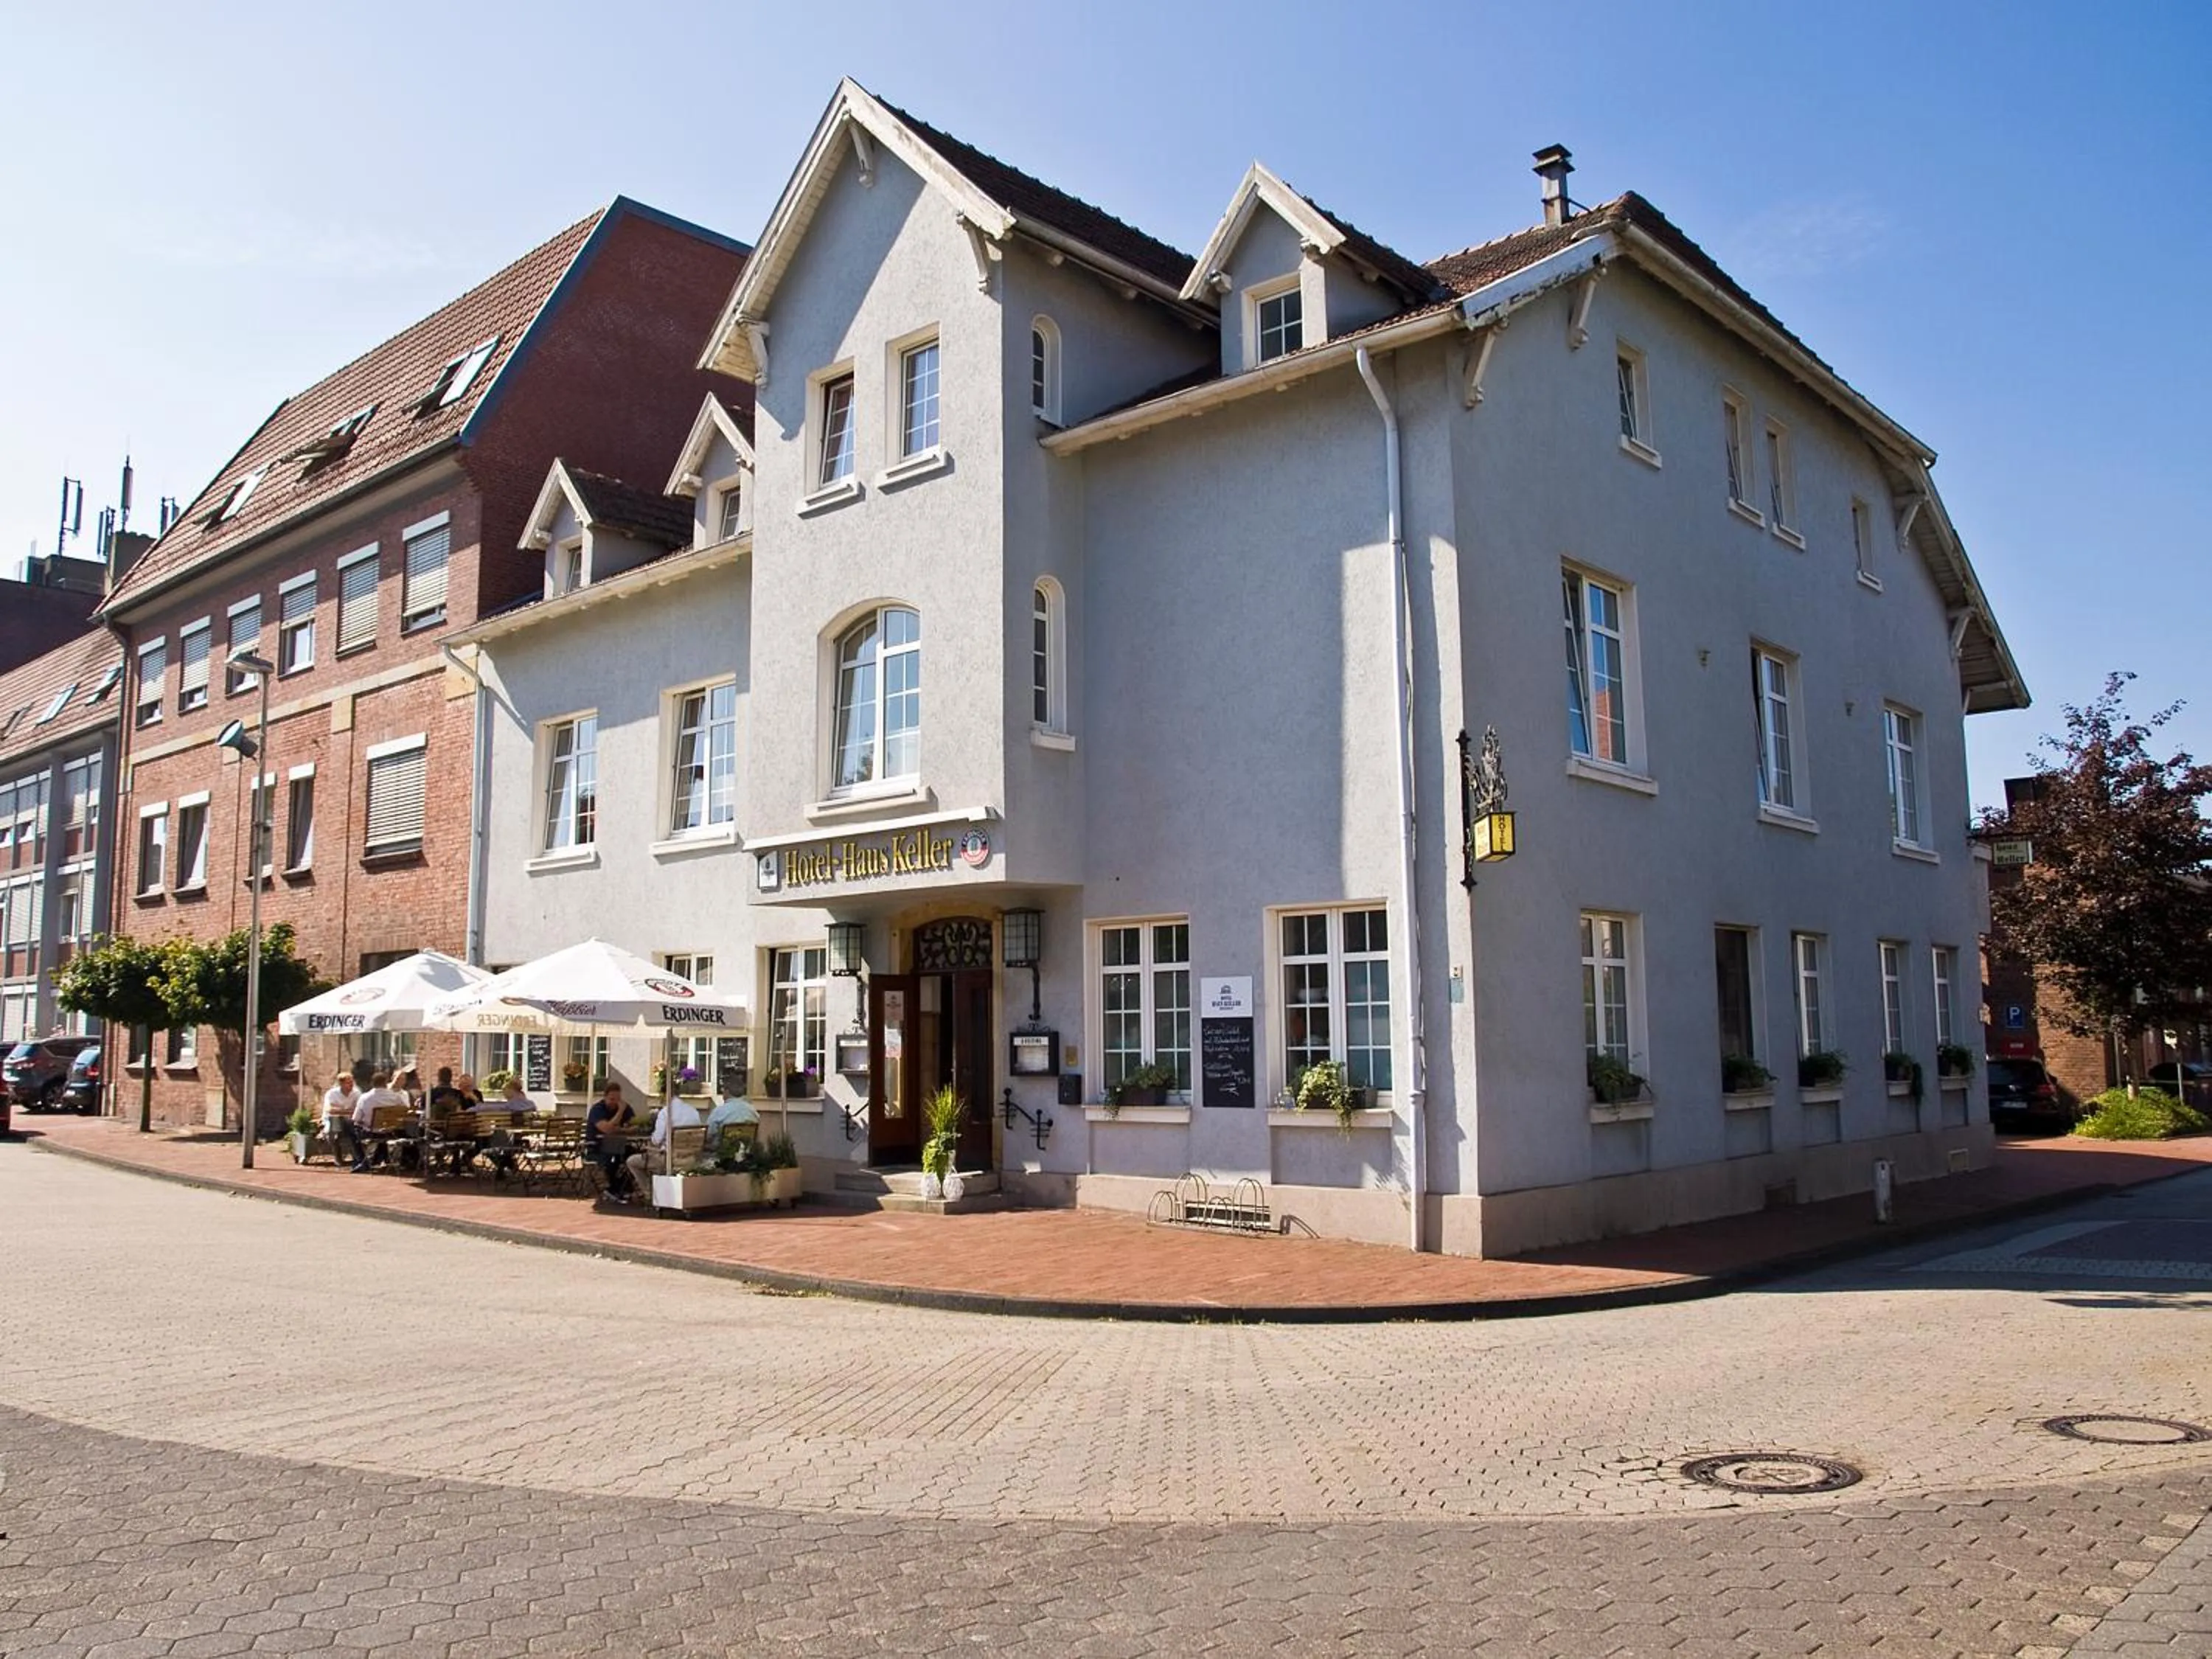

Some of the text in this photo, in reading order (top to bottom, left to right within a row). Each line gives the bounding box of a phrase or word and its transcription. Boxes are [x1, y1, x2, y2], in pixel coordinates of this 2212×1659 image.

[1498, 814, 1506, 852] HOTEL
[891, 829, 953, 872] Keller
[308, 1014, 366, 1029] ERDINGER
[662, 1004, 726, 1026] ERDINGER
[2008, 1006, 2020, 1020] P
